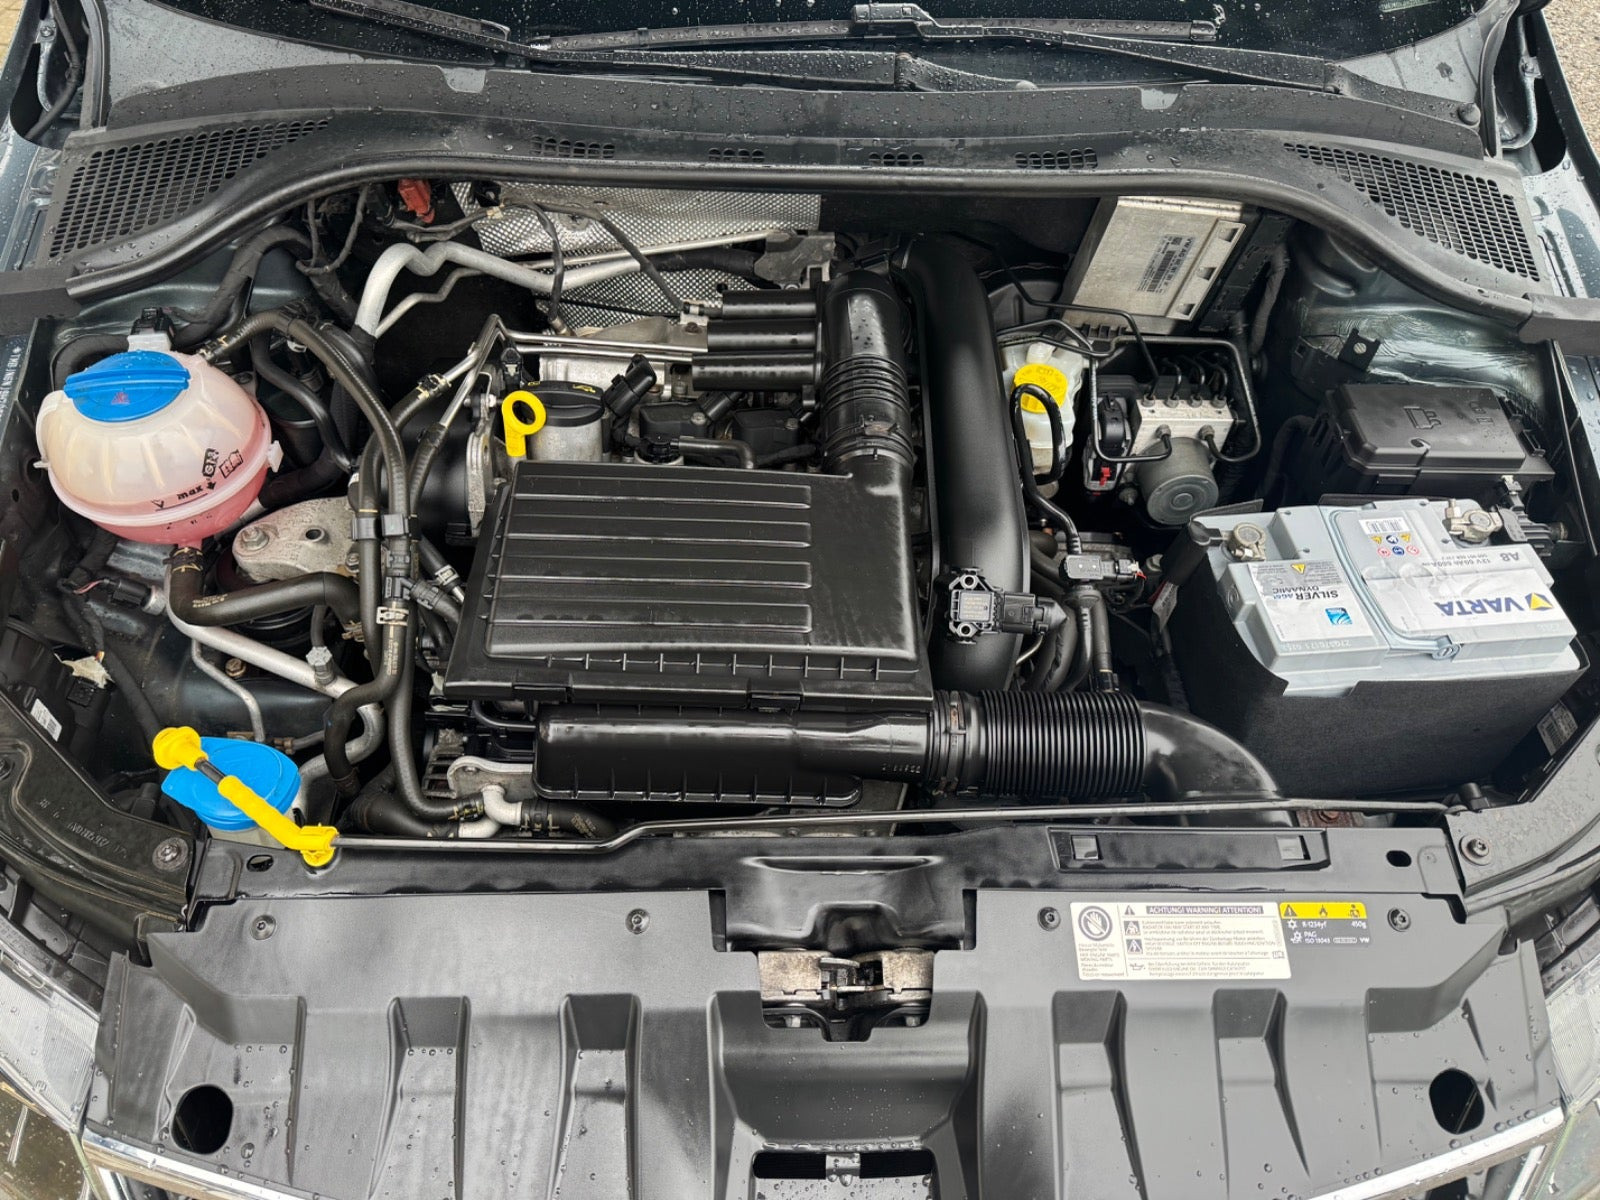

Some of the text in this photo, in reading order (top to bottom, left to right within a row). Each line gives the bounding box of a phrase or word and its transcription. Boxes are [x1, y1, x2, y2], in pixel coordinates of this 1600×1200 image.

[176, 485, 203, 500] max
[1500, 552, 1520, 561] A8
[1272, 585, 1319, 594] DYNAMIC
[1295, 590, 1339, 601] SILVER
[1433, 597, 1524, 616] VARTA
[1149, 906, 1261, 914] ACHTUNG! WARNING! ATTENTION!
